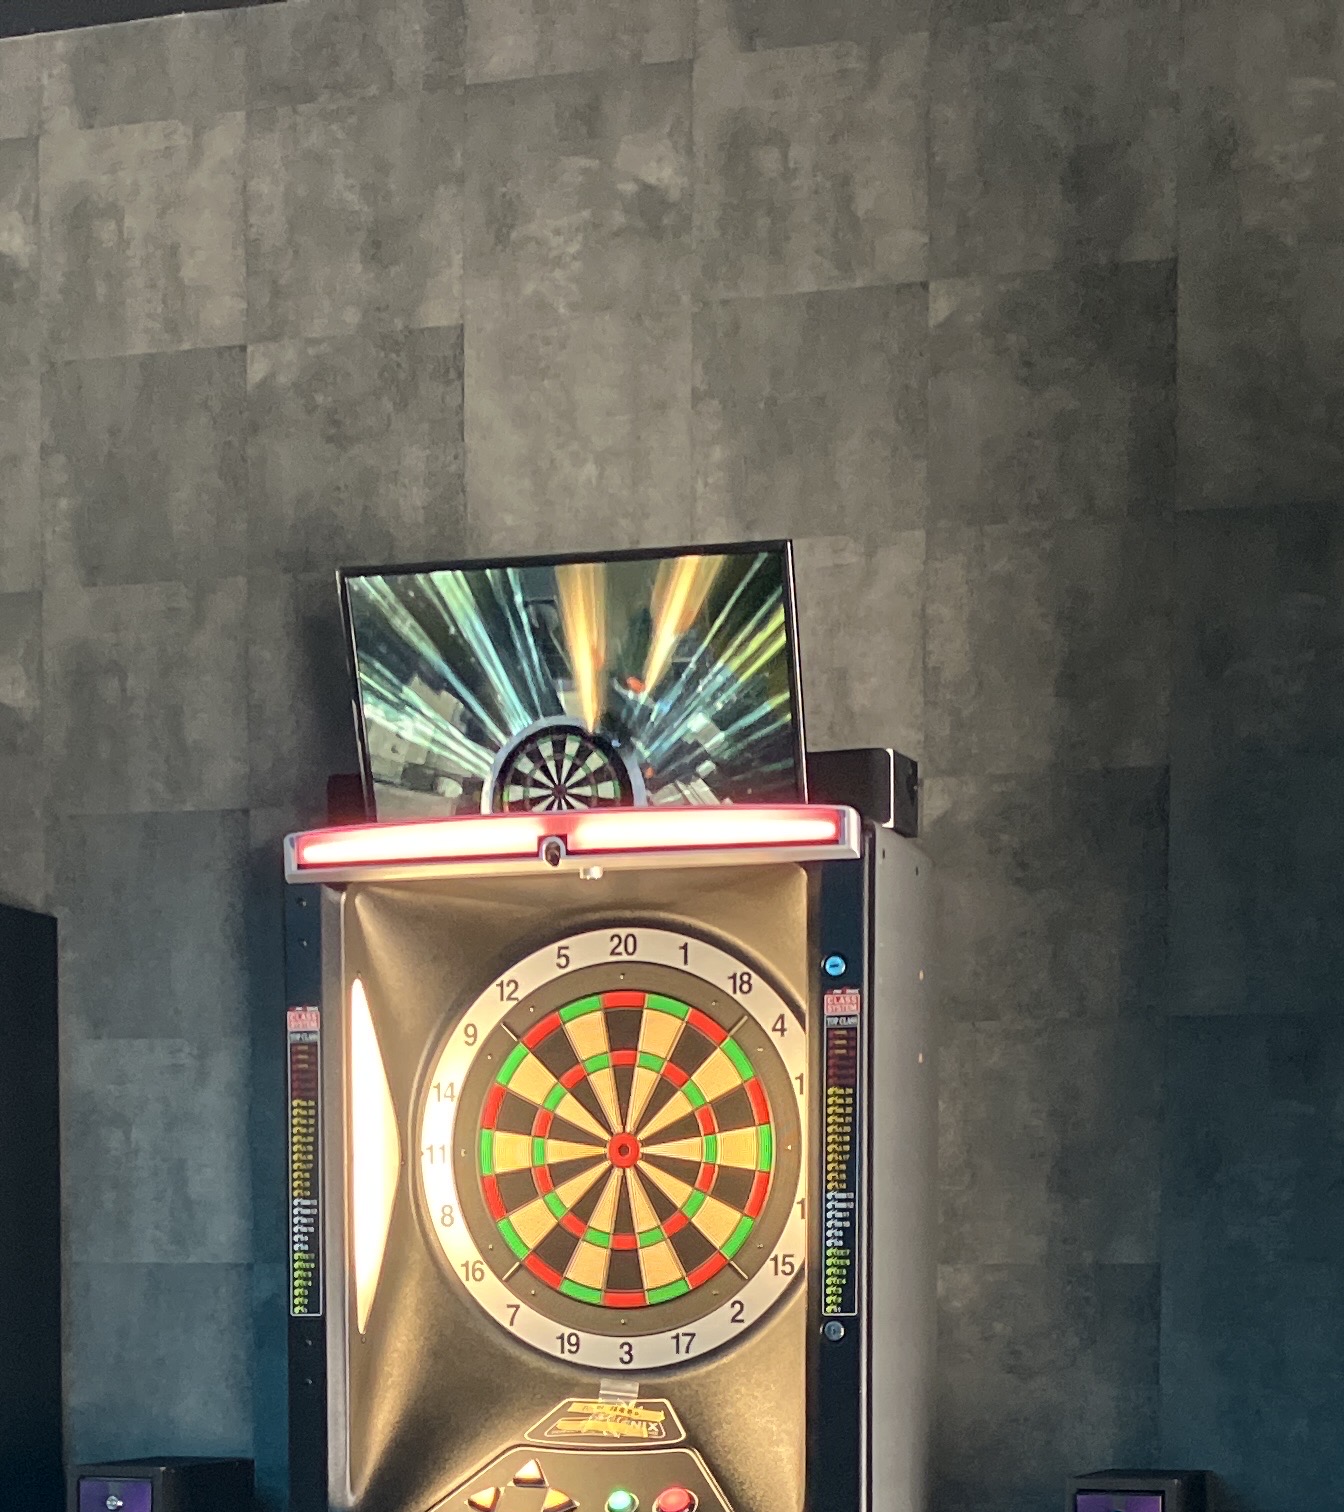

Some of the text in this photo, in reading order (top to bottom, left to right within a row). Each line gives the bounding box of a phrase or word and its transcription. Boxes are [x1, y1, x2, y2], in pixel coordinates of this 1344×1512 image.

[556, 946, 570, 968] 5
[609, 934, 638, 957] 20
[679, 942, 689, 966] 1
[496, 979, 520, 1002] 12
[728, 972, 753, 995] 18
[463, 1024, 478, 1045] 9
[772, 1014, 787, 1038] 4
[440, 1205, 455, 1228] 8
[461, 1260, 485, 1283] 16
[770, 1254, 795, 1277] 15
[506, 1304, 521, 1326] 7
[730, 1301, 745, 1324] 2
[556, 1333, 581, 1355] 19
[619, 1342, 634, 1365] 3
[672, 1333, 697, 1355] 17
